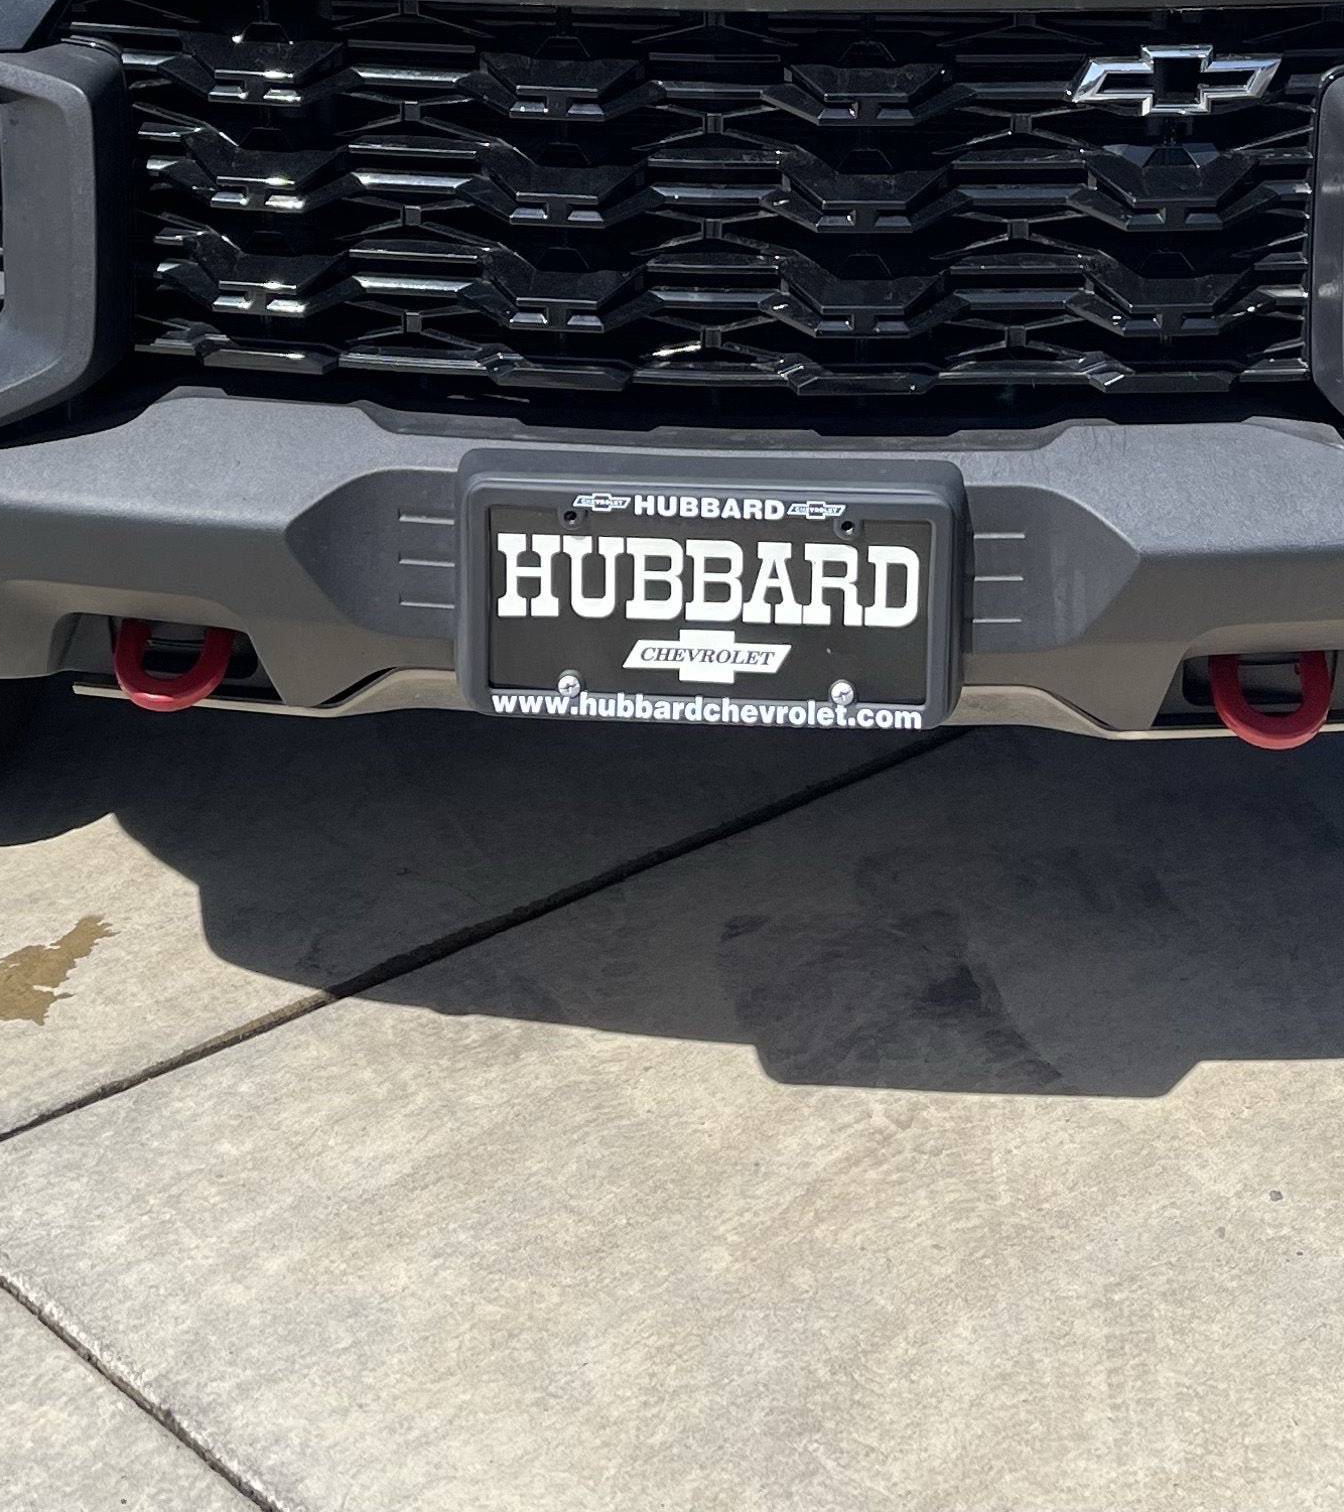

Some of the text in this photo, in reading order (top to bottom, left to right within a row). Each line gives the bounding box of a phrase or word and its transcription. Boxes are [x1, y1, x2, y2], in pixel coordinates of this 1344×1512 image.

[633, 494, 786, 521] HUBBARD
[497, 532, 920, 628] HUBBARD
[639, 645, 777, 667] CHEVROLET
[492, 691, 923, 730] www.hubbardchevrolet.com
